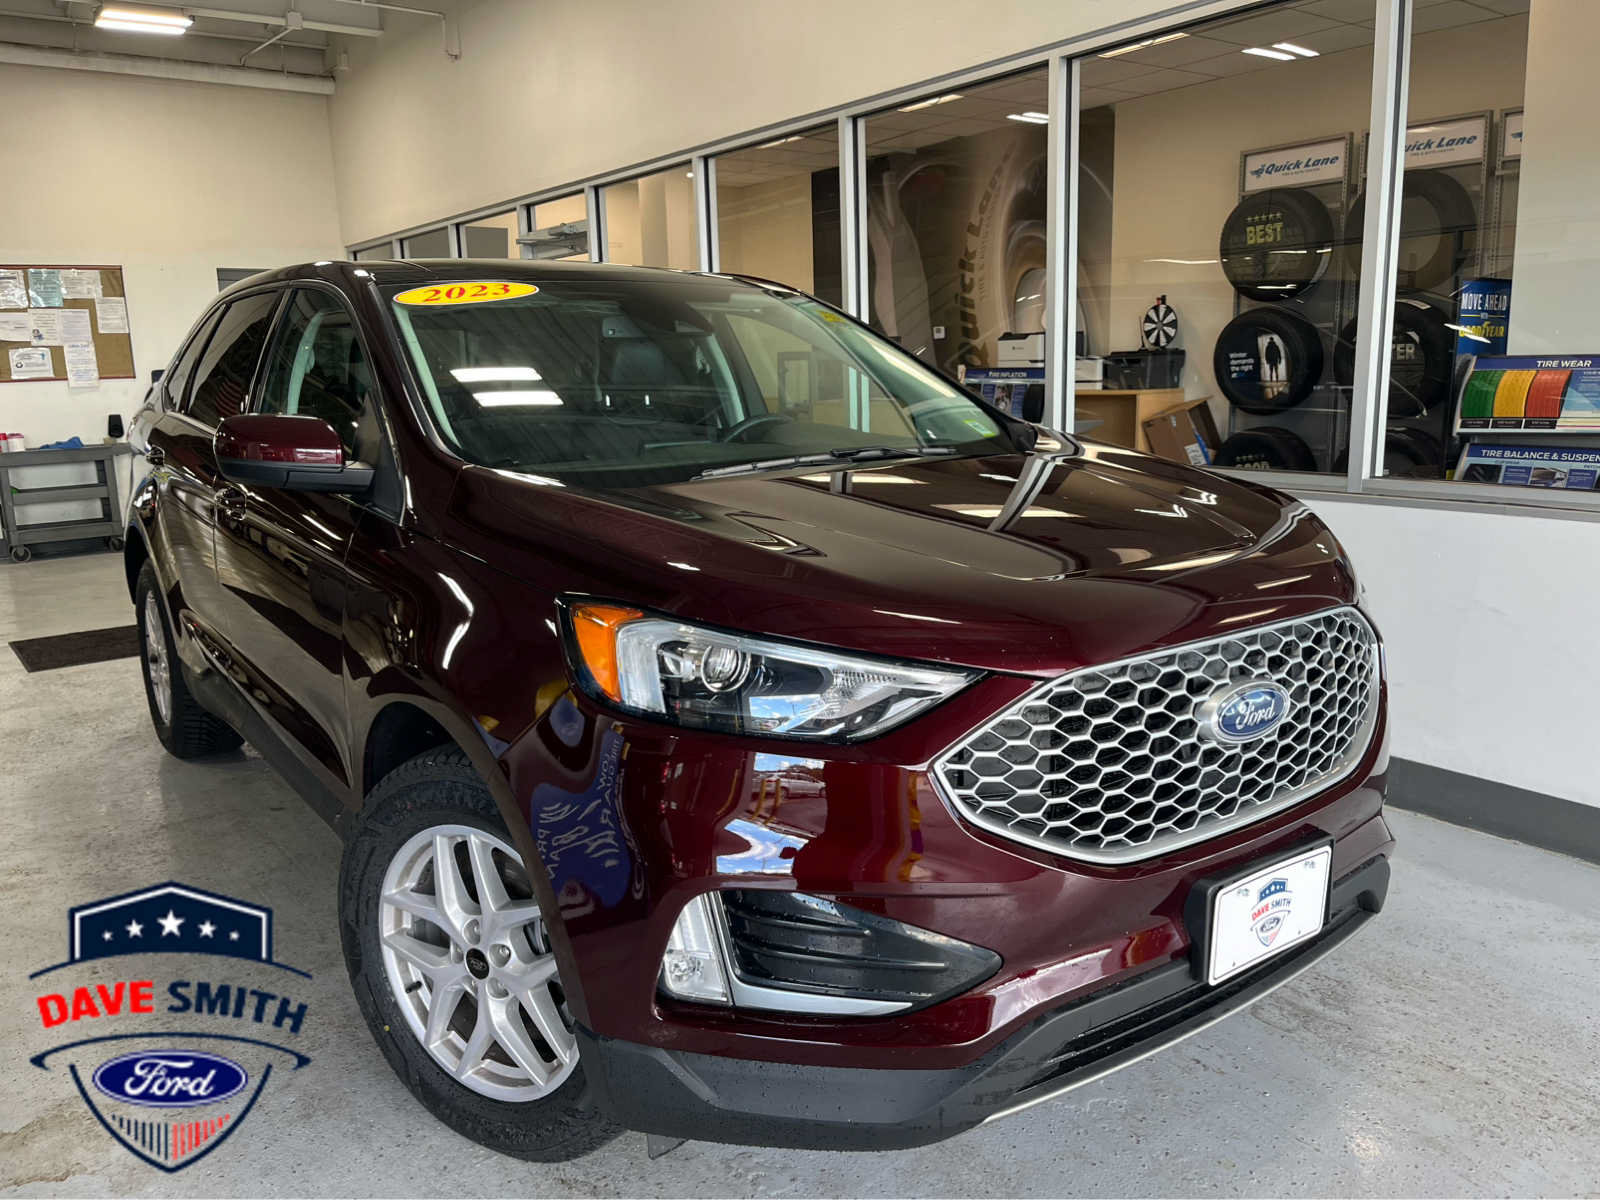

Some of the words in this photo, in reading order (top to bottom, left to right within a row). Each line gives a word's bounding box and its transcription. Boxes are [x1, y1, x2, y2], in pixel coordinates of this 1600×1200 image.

[1404, 139, 1436, 153] uick
[1437, 135, 1478, 148] Lane
[1264, 160, 1304, 175] Quick
[1304, 155, 1340, 169] Lane
[1246, 222, 1284, 245] BEST
[425, 284, 510, 302] 2023
[1461, 293, 1483, 310] MOVE
[1484, 294, 1507, 311] AHEAD
[1536, 360, 1560, 368] TIRE
[1560, 360, 1592, 368] WEAR
[1481, 449, 1503, 457] TIRE
[1503, 450, 1551, 461] BALANCE
[1551, 452, 1559, 460] &
[1234, 694, 1276, 730] Ford
[1251, 902, 1270, 921] DAVE
[1271, 897, 1292, 910] SMITH
